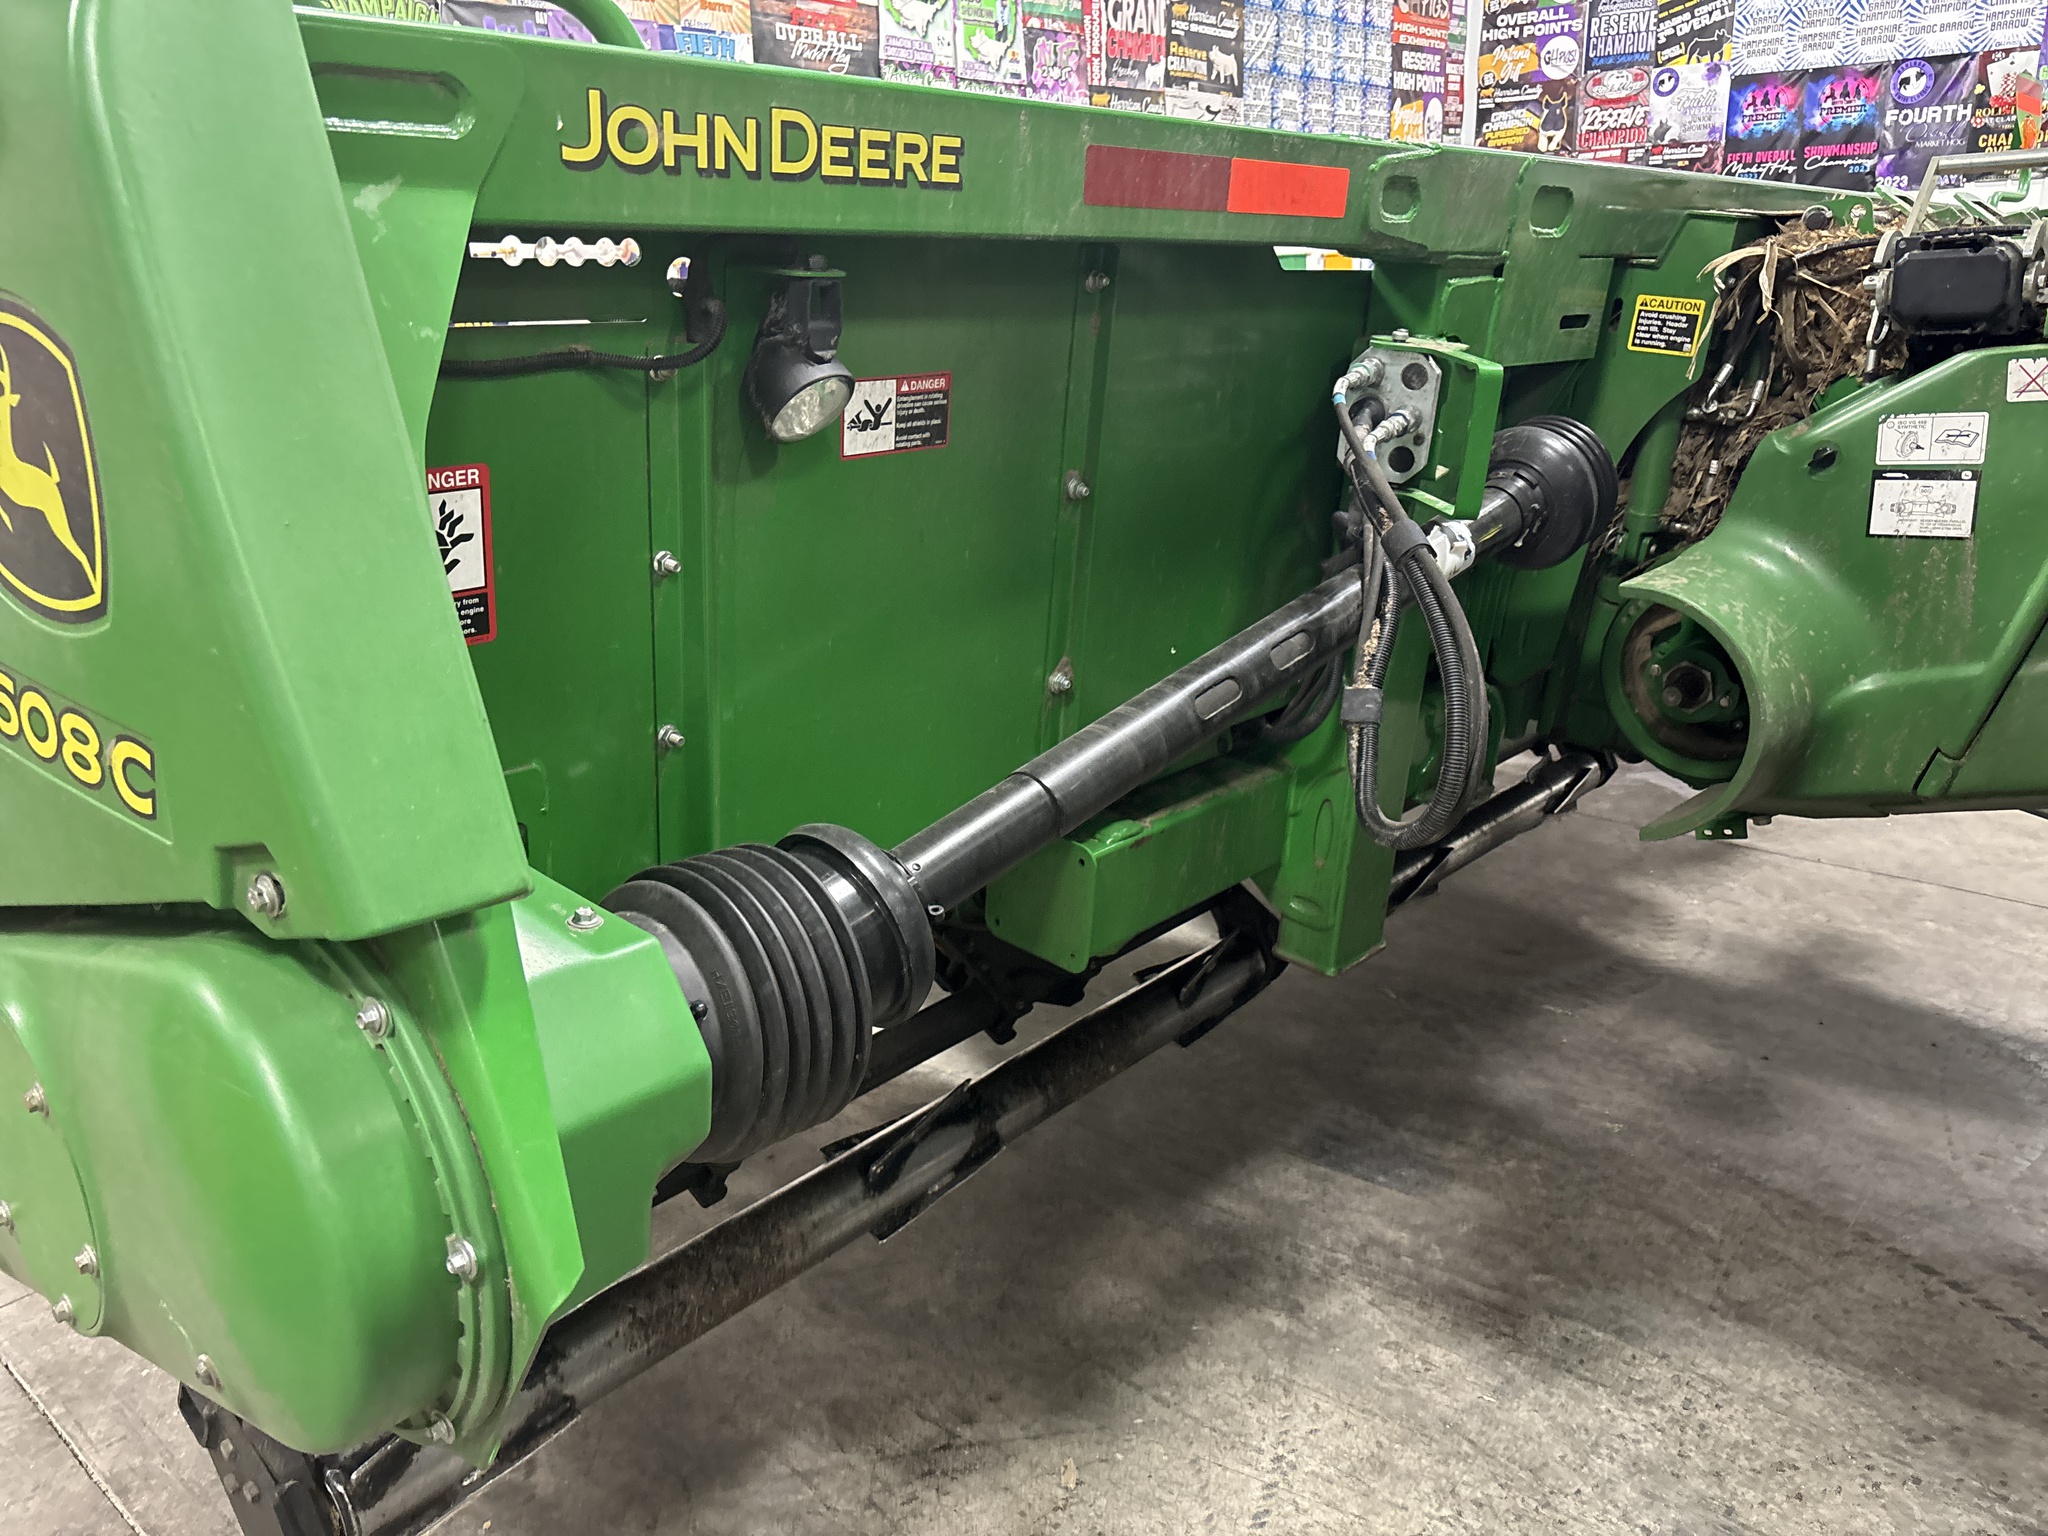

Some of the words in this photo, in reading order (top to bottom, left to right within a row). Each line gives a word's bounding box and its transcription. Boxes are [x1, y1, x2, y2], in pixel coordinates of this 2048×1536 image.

[1868, 0, 1897, 12] GRAND
[1923, 1, 1968, 15] CHAMPION
[1497, 7, 1569, 27] OVERALL
[1807, 8, 1834, 19] GRAND
[1860, 9, 1903, 22] CHAMPION
[1986, 7, 2037, 22] HAMPSHIRE
[1590, 10, 1658, 37] RESERVE
[1676, 6, 1734, 37] OVERALL
[1753, 15, 1778, 26] GRAND
[1801, 17, 1840, 29] CHAMPION
[1990, 18, 2029, 31] BARROW
[1394, 22, 1418, 34] HIGH
[1482, 27, 1520, 42] HIGH
[1522, 19, 1583, 38] POINTS
[1745, 24, 1784, 36] CHAMPION
[1855, 23, 1903, 37] HAMPSHIRE
[1909, 24, 1937, 36] DUROC
[775, 22, 862, 51] OVERALL
[1399, 34, 1446, 49] EXHIBITOR
[1797, 31, 1841, 43] HAMPSHIRE
[1860, 34, 1896, 46] BARROW
[1588, 31, 1657, 58] CHAMPION
[1741, 37, 1785, 50] HAMPSHIRE
[1802, 41, 1835, 52] BARROW
[1170, 41, 1207, 60] Reserve
[1491, 44, 1533, 67] Poland
[1746, 47, 1778, 58] BARROW
[1402, 50, 1441, 73] RESERVE
[1393, 71, 1416, 91] HIGH
[1416, 75, 1444, 94] POINTS
[1671, 88, 1717, 111] Fourth
[1491, 108, 1526, 122] GRAND
[1820, 104, 1867, 116] PREMIER
[1885, 104, 1972, 126] FOURTH
[1580, 105, 1650, 132] RESERVE
[1691, 114, 1712, 123] JUNIOR
[1742, 112, 1787, 123] PREMIER
[1483, 117, 1533, 133] CHAMPION
[560, 87, 761, 181] JOHN
[770, 106, 964, 190] DEERE
[1576, 127, 1647, 148] CHAMPION
[1915, 140, 1946, 148] MARKET
[1946, 138, 1966, 147] HOG
[1804, 142, 1878, 158] SHOWMANSHIP
[1727, 153, 1753, 164] FIFTH
[1756, 150, 1796, 163] OVERALL
[1849, 165, 1870, 173] 2023
[1876, 176, 1908, 187] 2023
[1649, 299, 1702, 312] CAUTION
[1659, 313, 1687, 323] crushing
[1666, 320, 1689, 329] Header
[1662, 327, 1677, 336] Stay
[1641, 339, 1667, 348] running.
[910, 378, 945, 391] DANGER
[428, 469, 480, 489] NGER
[462, 597, 480, 606] from
[460, 606, 485, 616] engine
